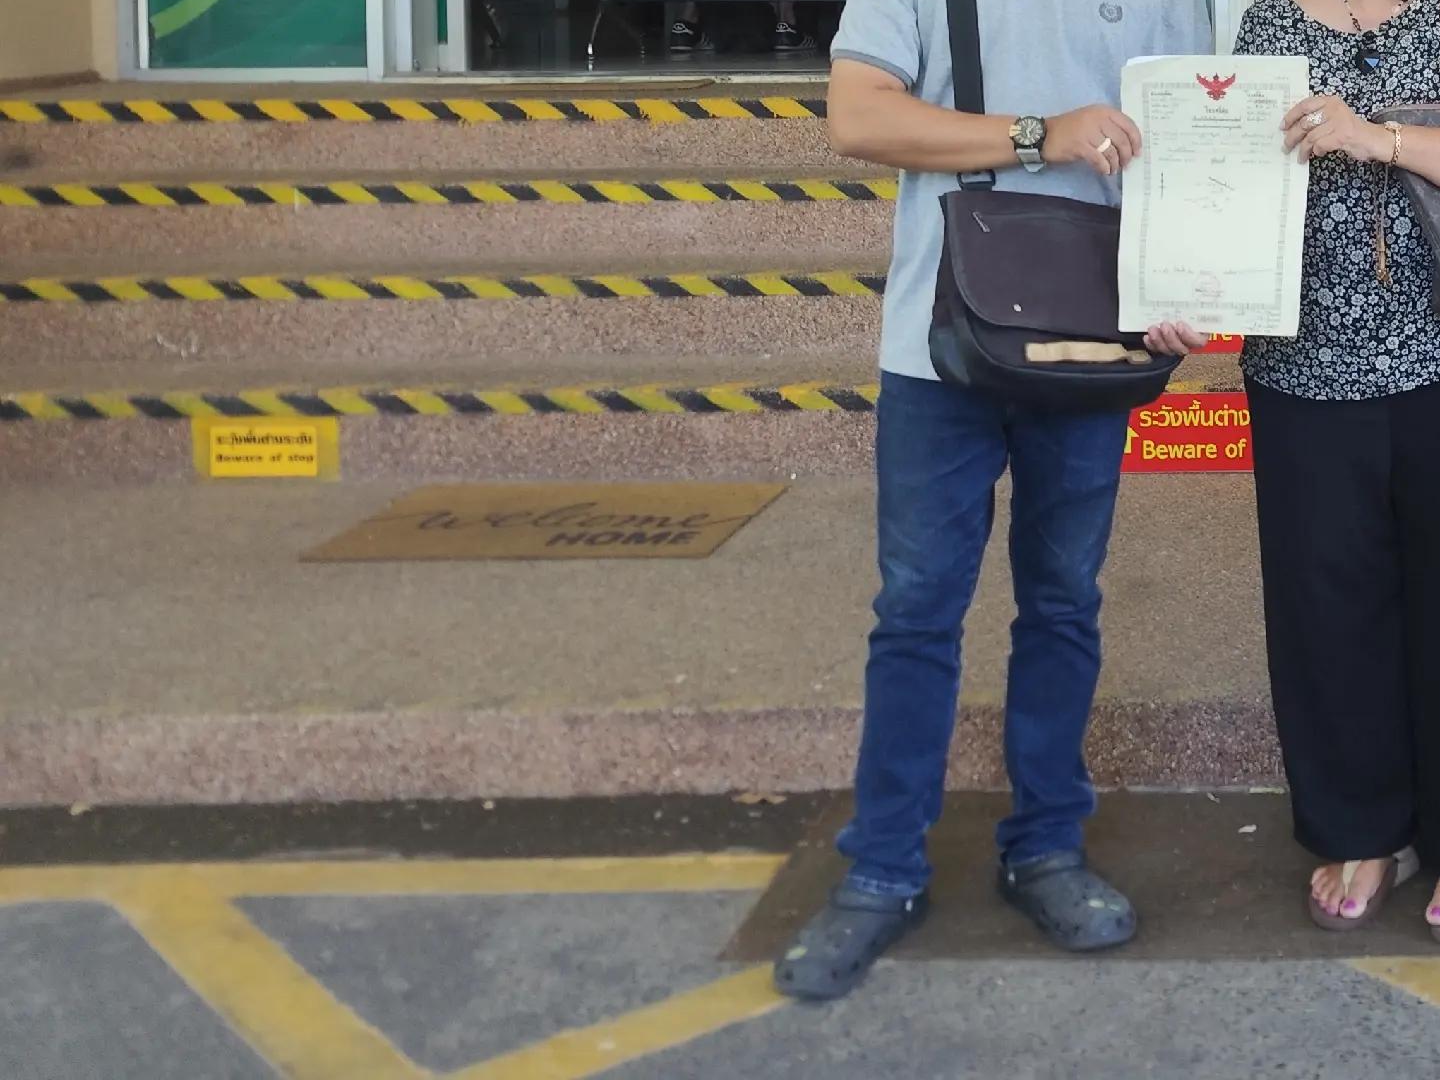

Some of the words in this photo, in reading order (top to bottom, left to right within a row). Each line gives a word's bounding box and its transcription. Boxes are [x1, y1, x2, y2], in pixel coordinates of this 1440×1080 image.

[1139, 400, 1250, 427] ระวังพื้นต่าง
[1142, 439, 1218, 459] Beware
[1224, 438, 1247, 458] of
[545, 531, 702, 547] HOME
